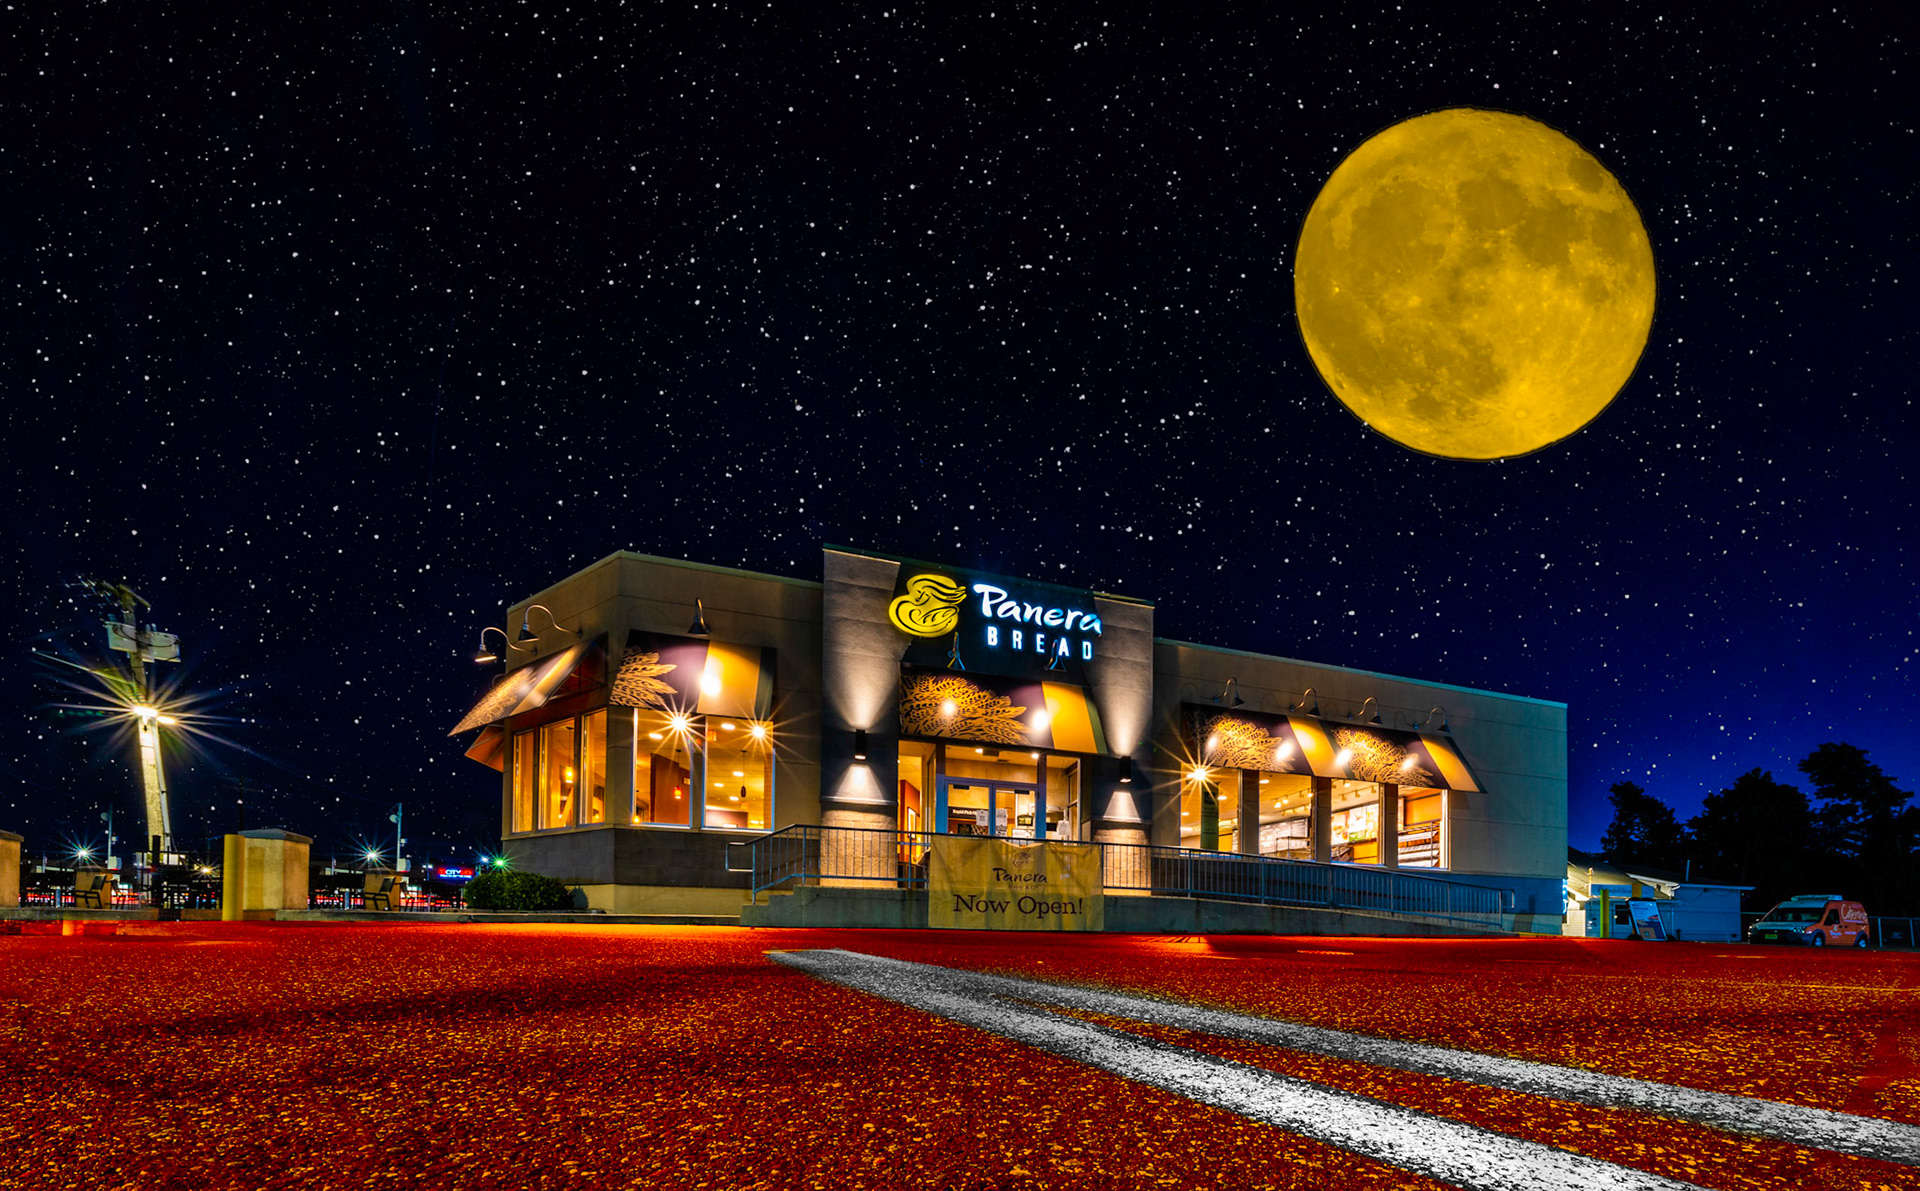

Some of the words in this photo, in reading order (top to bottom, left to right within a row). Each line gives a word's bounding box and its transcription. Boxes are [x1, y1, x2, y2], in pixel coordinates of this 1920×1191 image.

[973, 582, 1102, 635] Panera
[986, 625, 1093, 661] BREAD
[992, 867, 1047, 883] Panera
[953, 894, 1011, 914] Now
[1018, 896, 1084, 919] Open!
